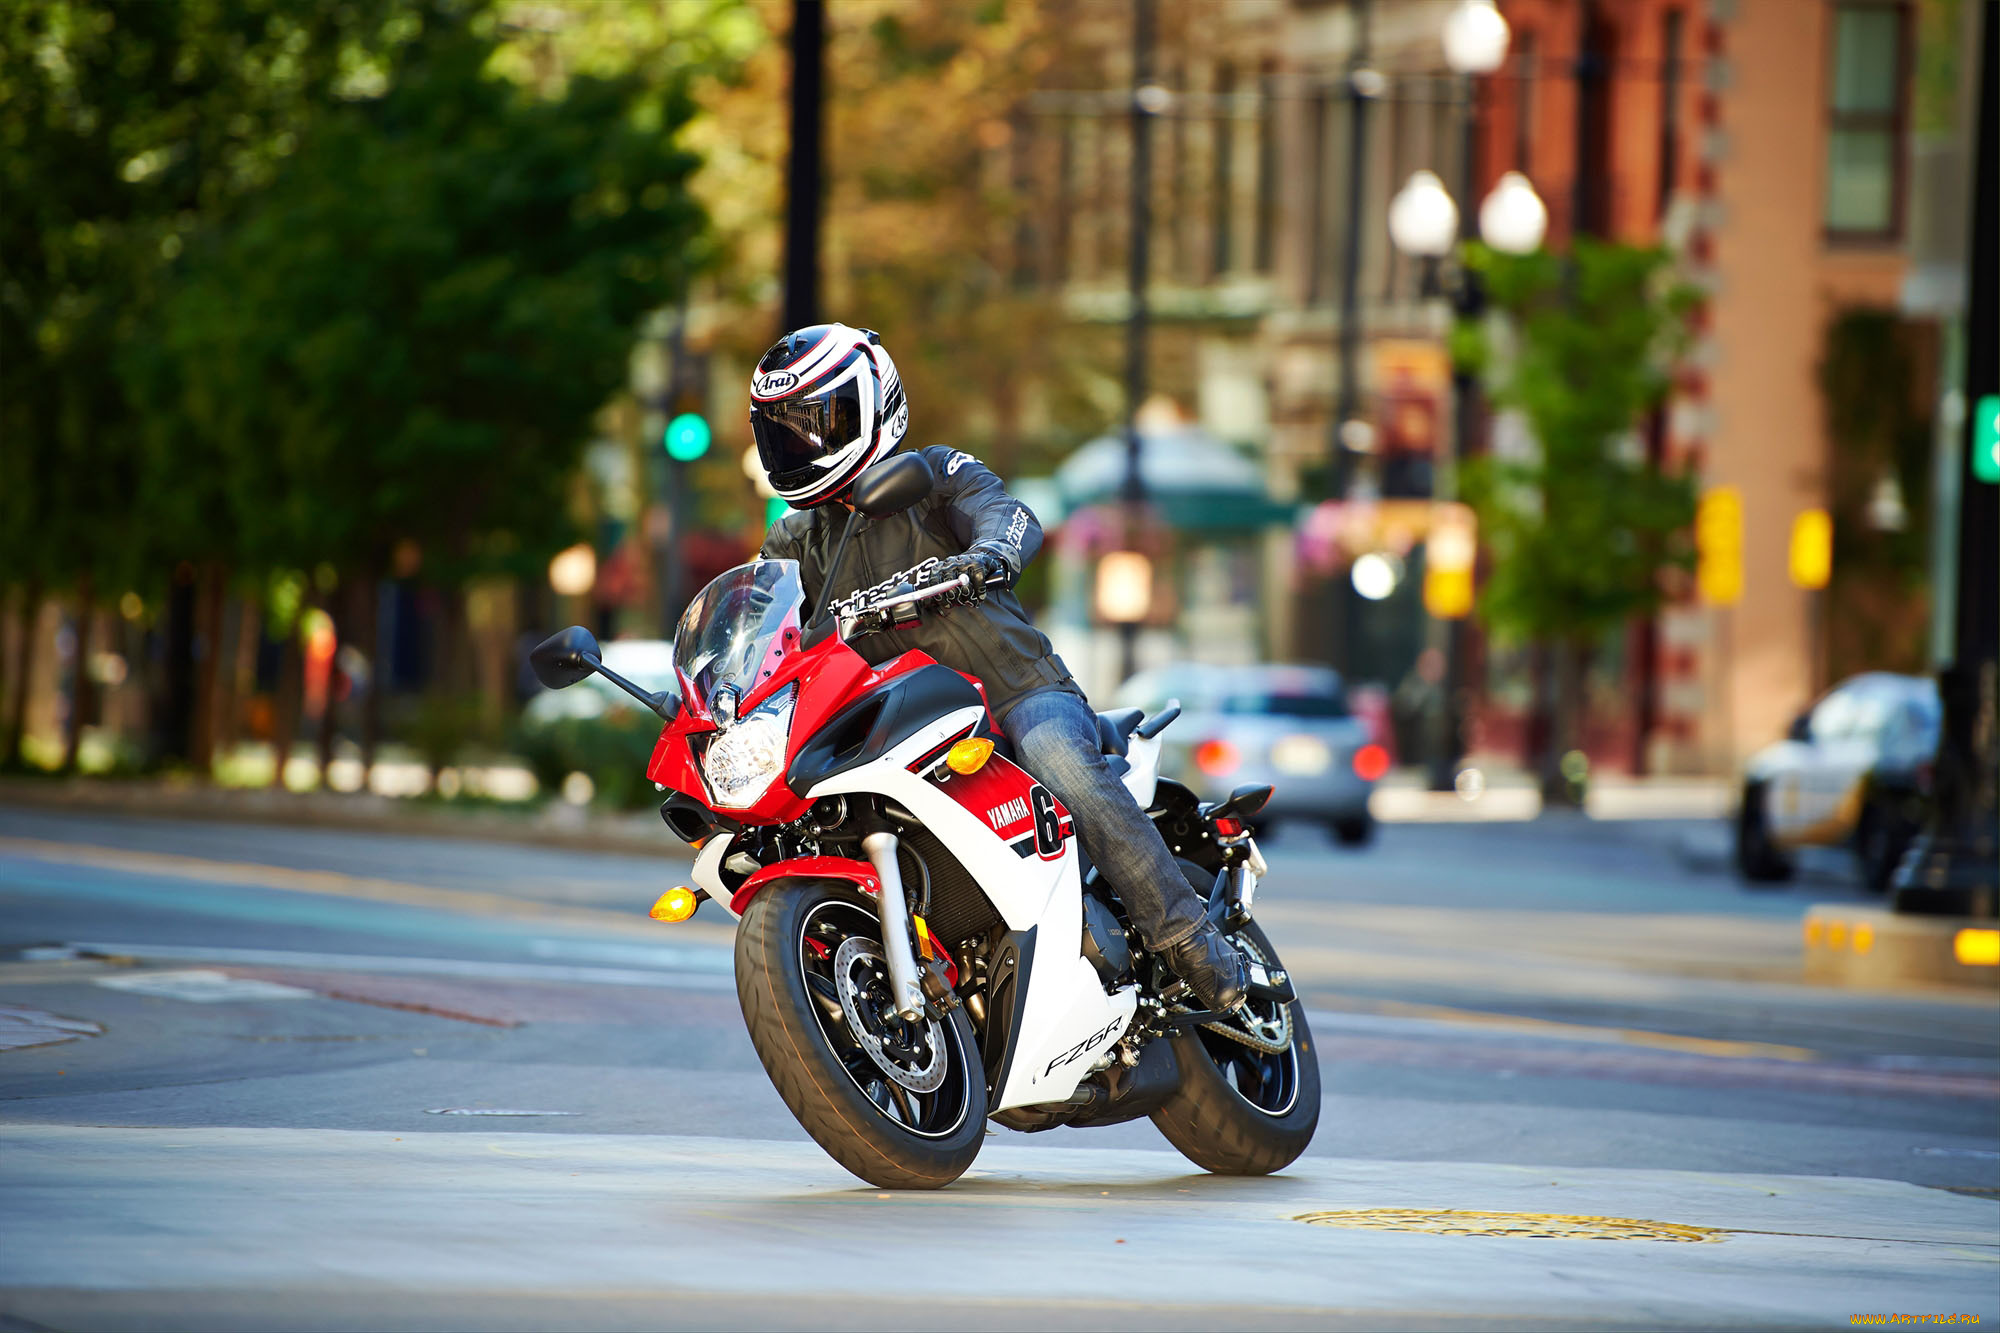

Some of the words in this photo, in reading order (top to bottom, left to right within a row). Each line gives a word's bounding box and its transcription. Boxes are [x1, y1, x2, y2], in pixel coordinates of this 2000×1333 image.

[758, 373, 792, 393] Arai
[986, 796, 1030, 831] YAMAHA
[1044, 1015, 1123, 1078] FZ6R
